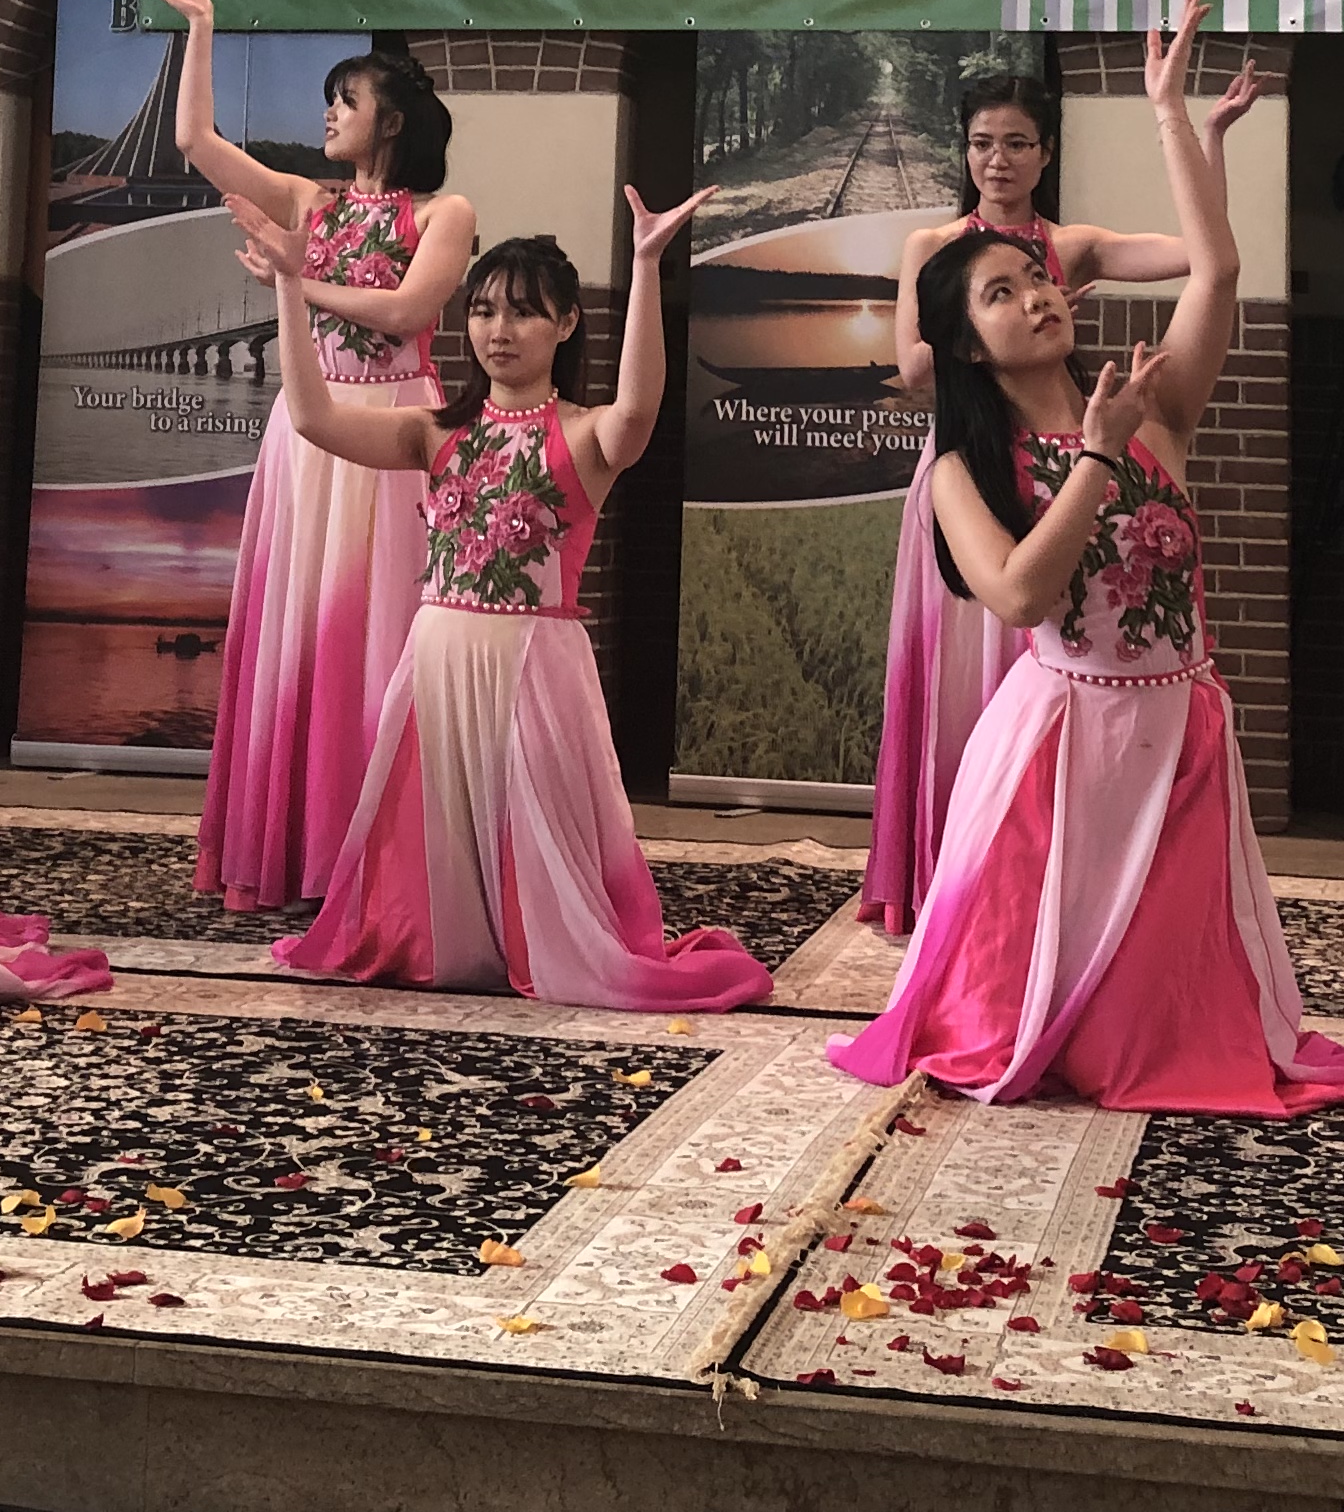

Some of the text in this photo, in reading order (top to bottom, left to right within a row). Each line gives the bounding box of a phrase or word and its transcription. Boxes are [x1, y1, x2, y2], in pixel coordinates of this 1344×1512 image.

[73, 386, 203, 415] Your bridge
[713, 398, 793, 422] Where
[798, 407, 855, 430] your
[149, 412, 261, 440] to a rising
[754, 424, 798, 446] will
[806, 428, 865, 449] meet
